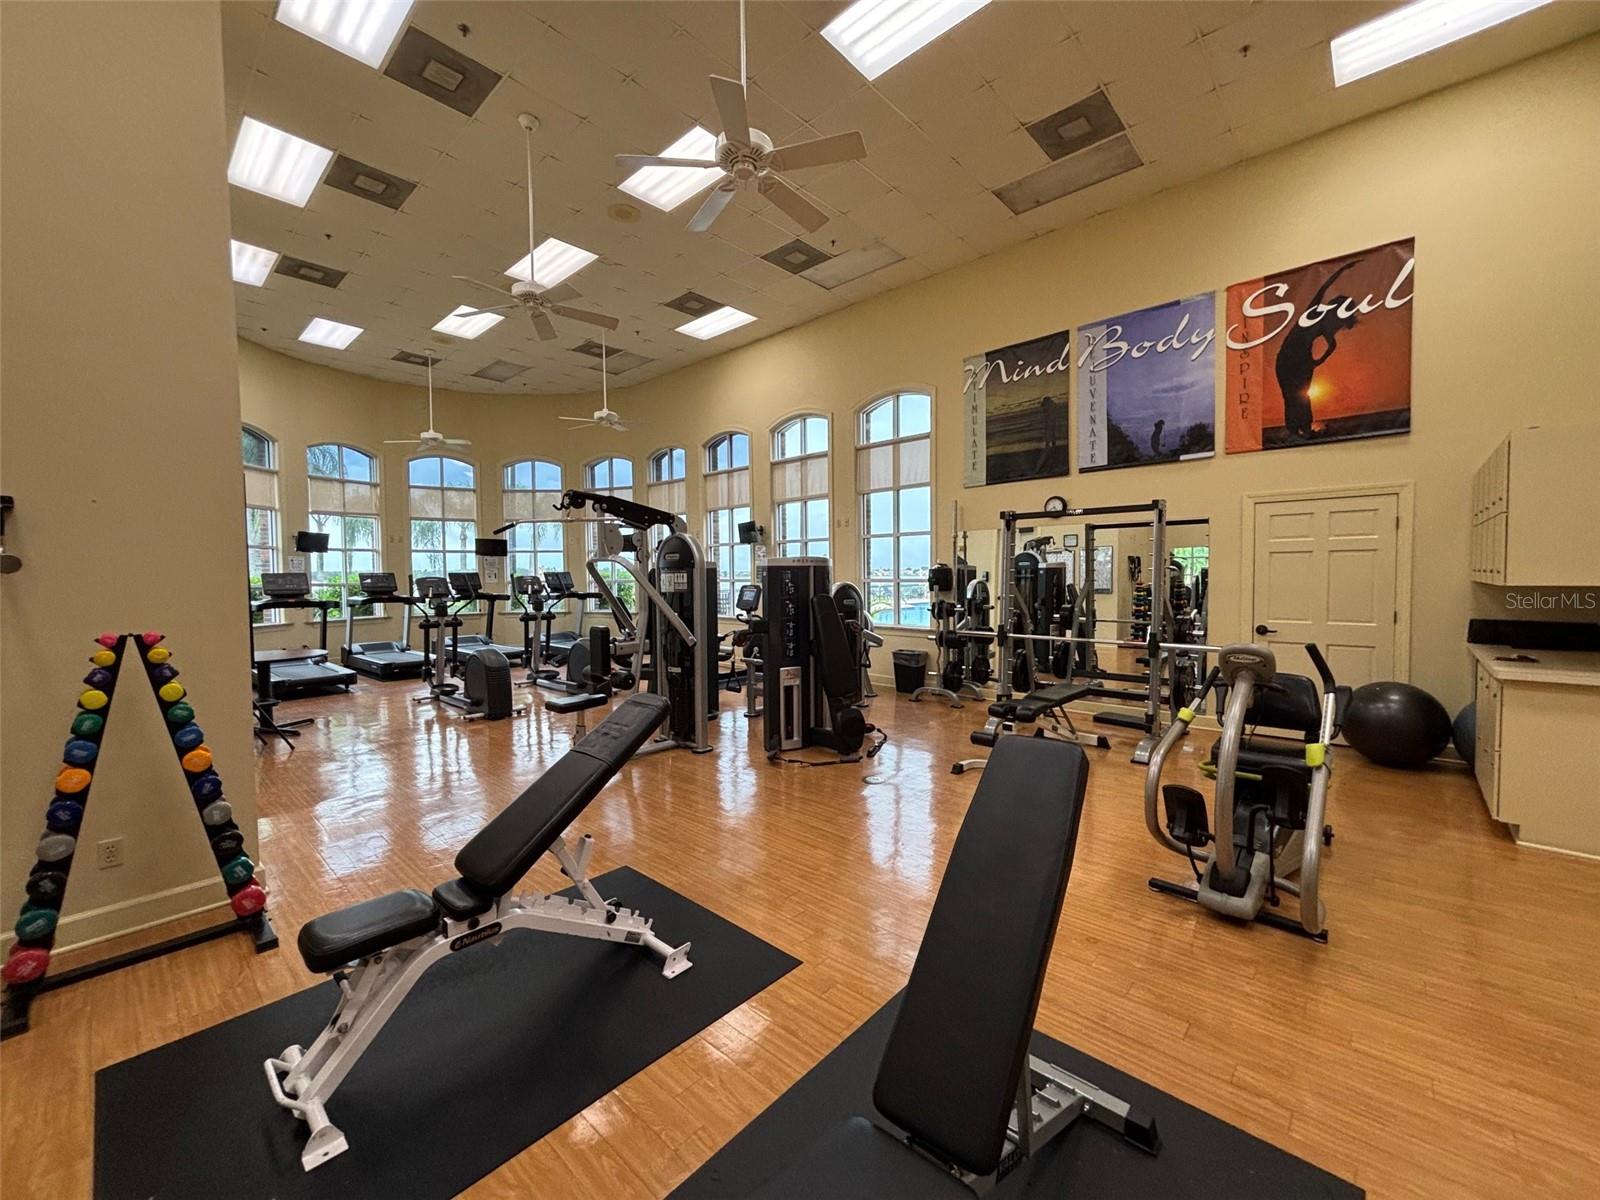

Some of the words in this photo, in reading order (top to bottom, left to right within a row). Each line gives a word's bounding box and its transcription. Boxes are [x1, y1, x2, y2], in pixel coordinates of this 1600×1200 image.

[1226, 257, 1415, 350] Soul
[963, 342, 1070, 395] Mind
[1077, 313, 1215, 372] Body
